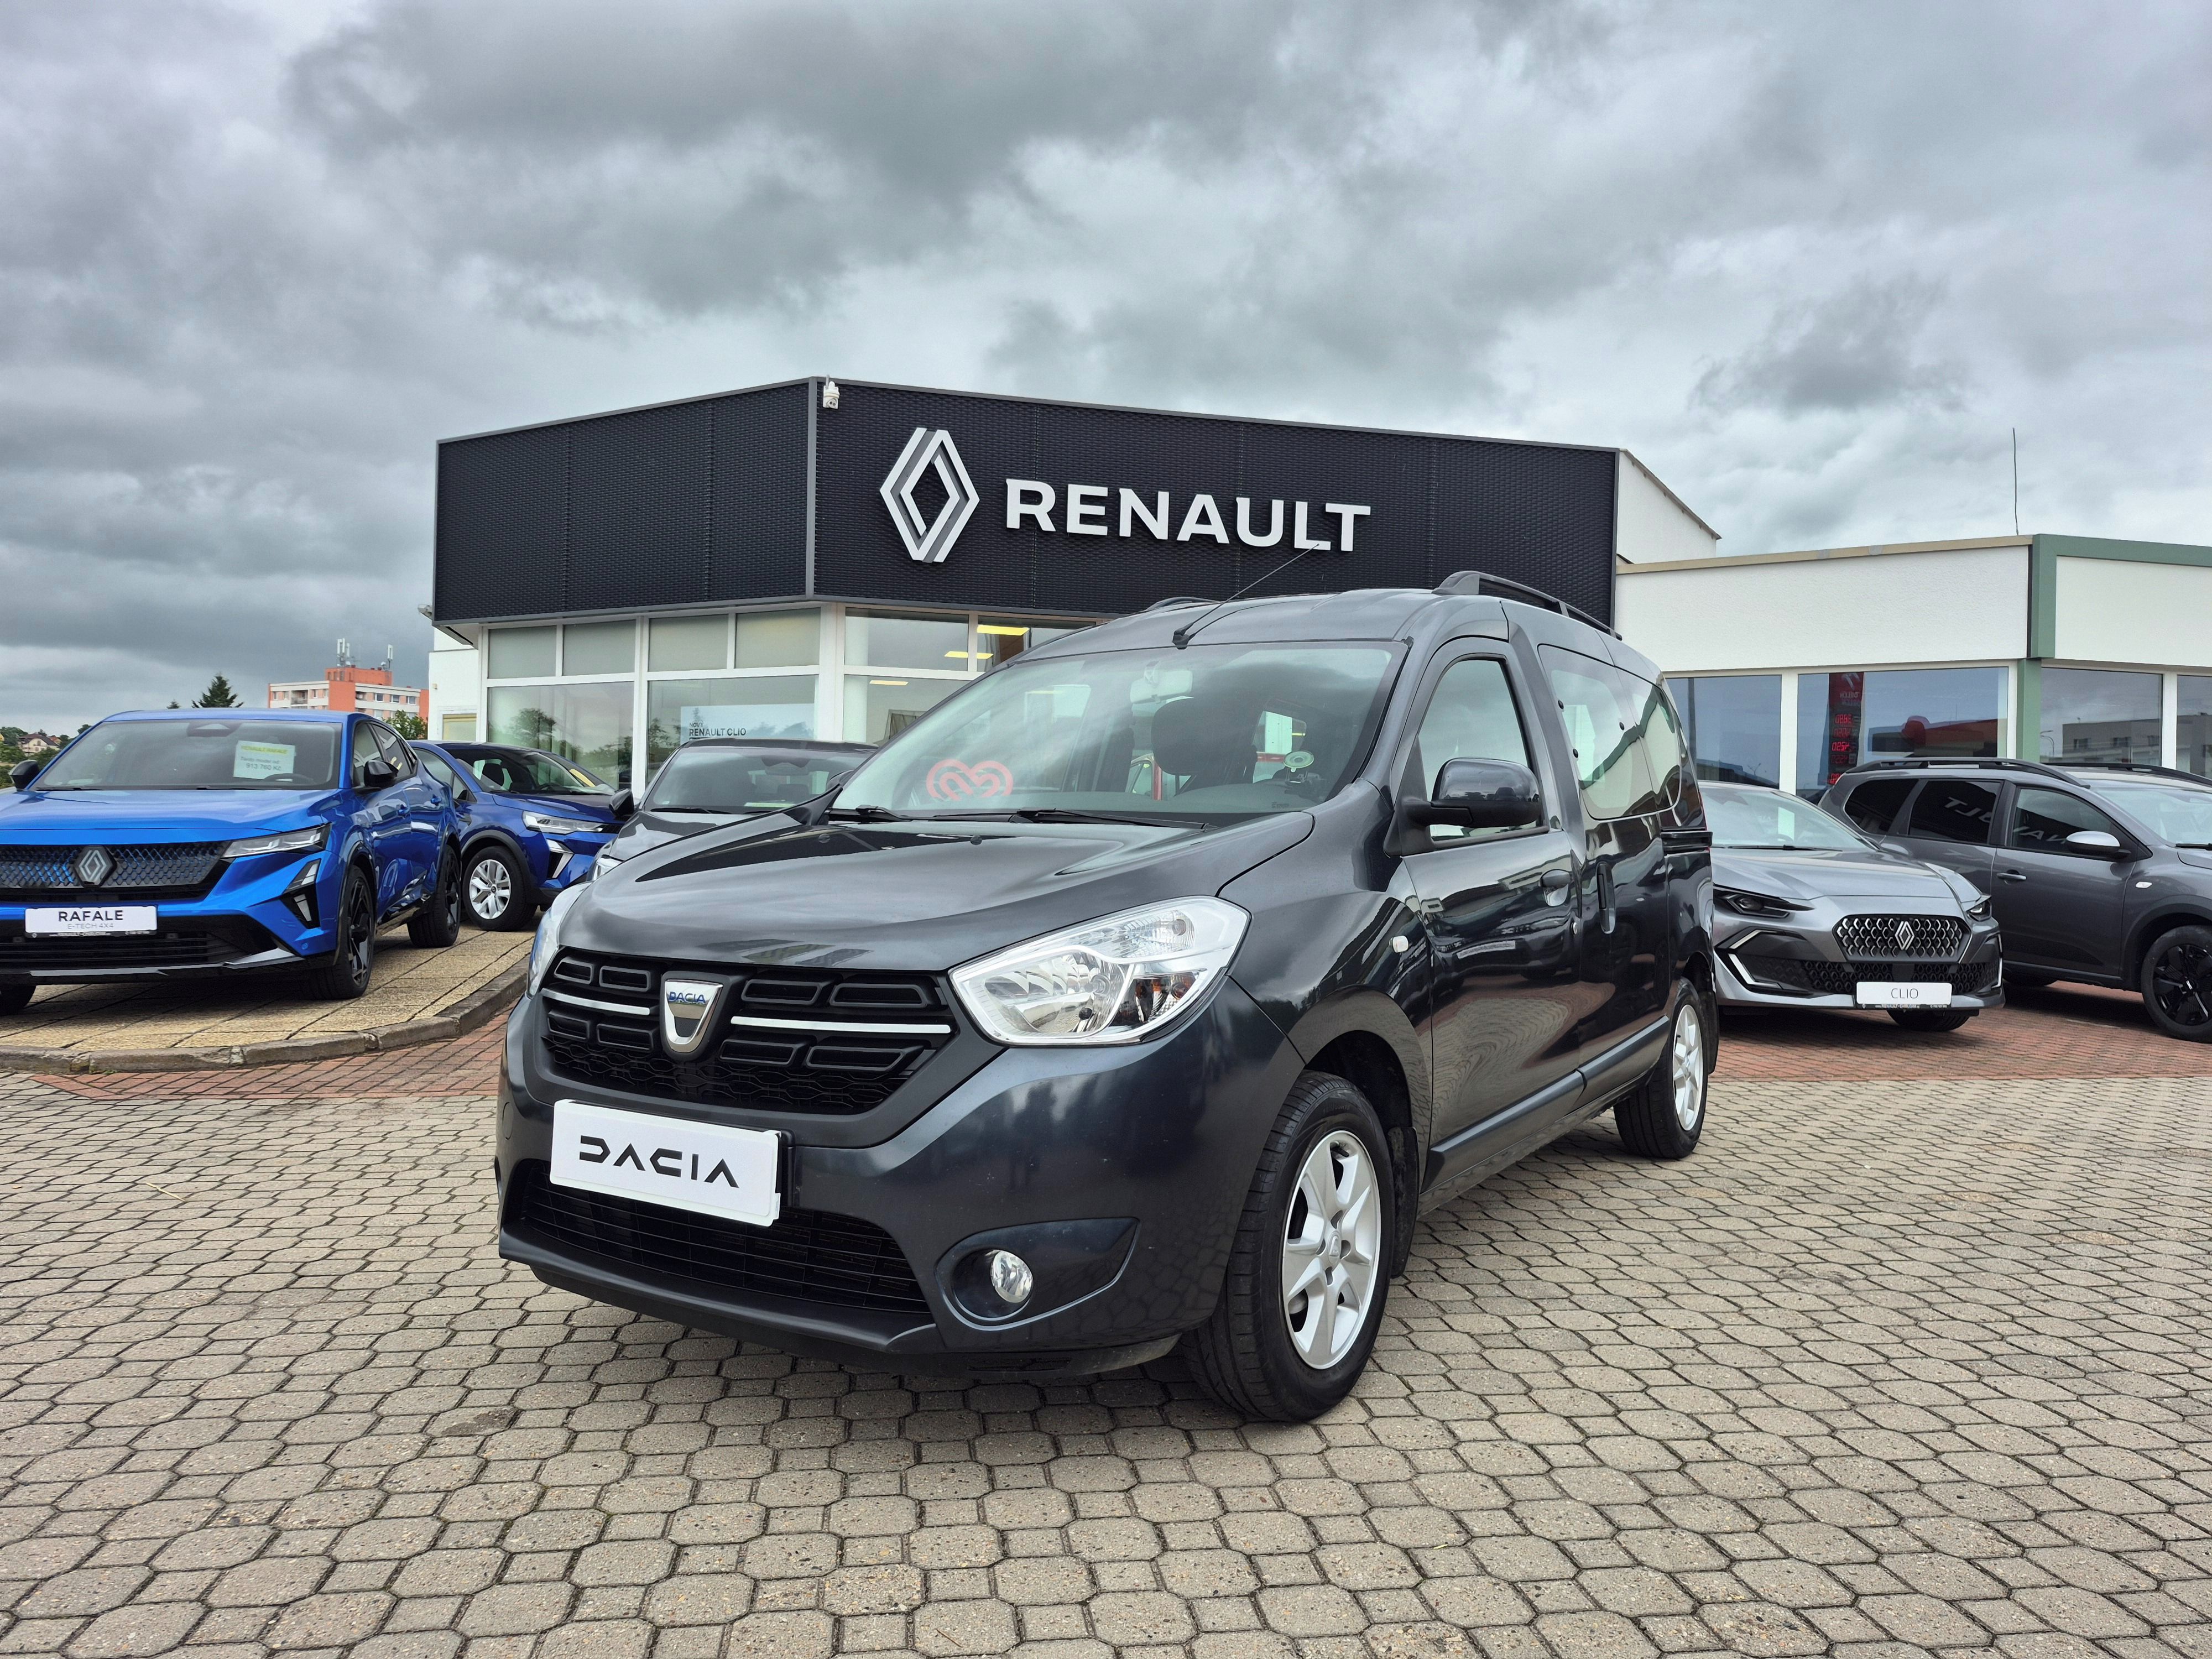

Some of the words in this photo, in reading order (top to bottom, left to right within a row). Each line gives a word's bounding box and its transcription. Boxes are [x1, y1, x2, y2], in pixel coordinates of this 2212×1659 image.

[1005, 478, 1371, 552] RENAULT
[689, 728, 726, 737] RENAULT
[727, 728, 747, 736] CLIO
[58, 910, 124, 922] RAFALE
[667, 991, 706, 1005] DACIA
[1891, 988, 1919, 999] CLIO
[579, 1135, 740, 1188] DACIA
